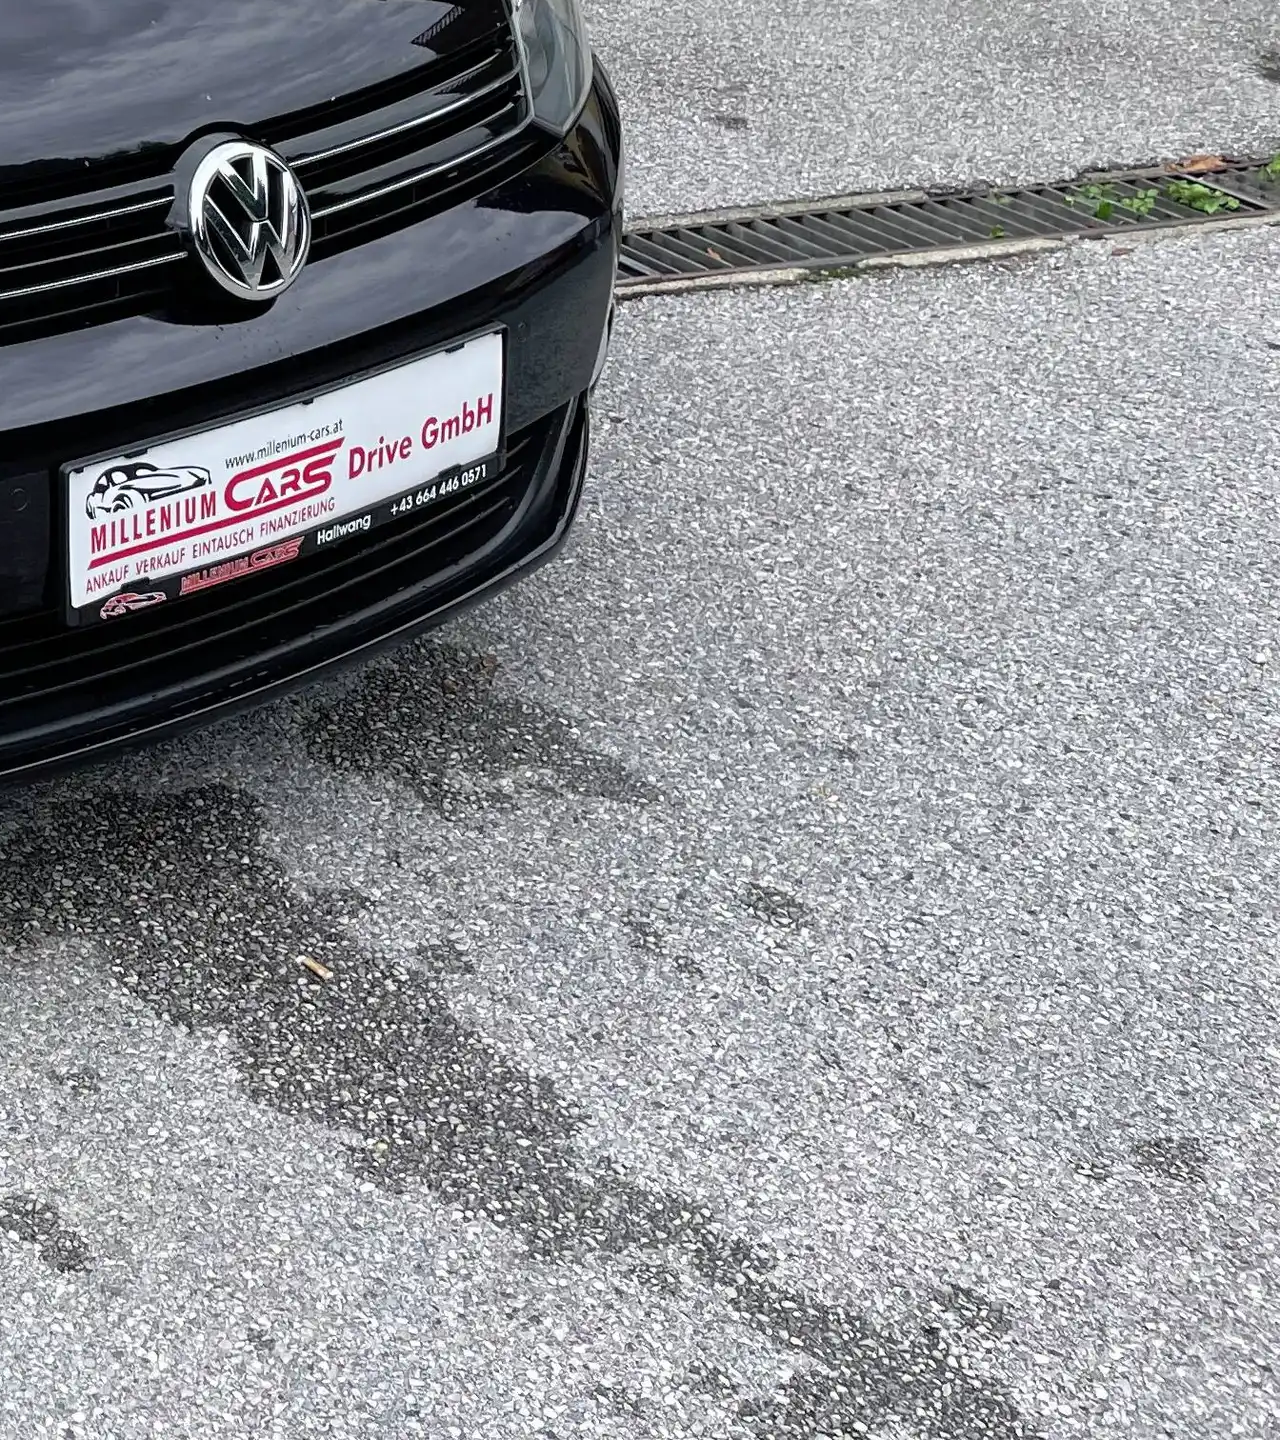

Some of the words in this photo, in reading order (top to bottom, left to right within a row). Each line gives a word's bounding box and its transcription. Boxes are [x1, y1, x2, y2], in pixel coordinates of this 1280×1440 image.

[90, 490, 217, 554] MILLENIUM
[223, 437, 345, 512] CARS
[348, 436, 413, 480] Drive
[421, 393, 493, 450] GmbH
[225, 418, 344, 469] www.millenium-cars.at
[86, 564, 130, 595] ANKAUF
[135, 547, 186, 575] VERKAUF
[192, 527, 254, 559] EINTAUSCH
[259, 496, 336, 535] FINANZIERUNG
[316, 514, 372, 545] Hallwang
[390, 495, 414, 516] +43
[415, 484, 437, 505] 664
[439, 475, 460, 496] 446
[461, 463, 487, 487] 0571
